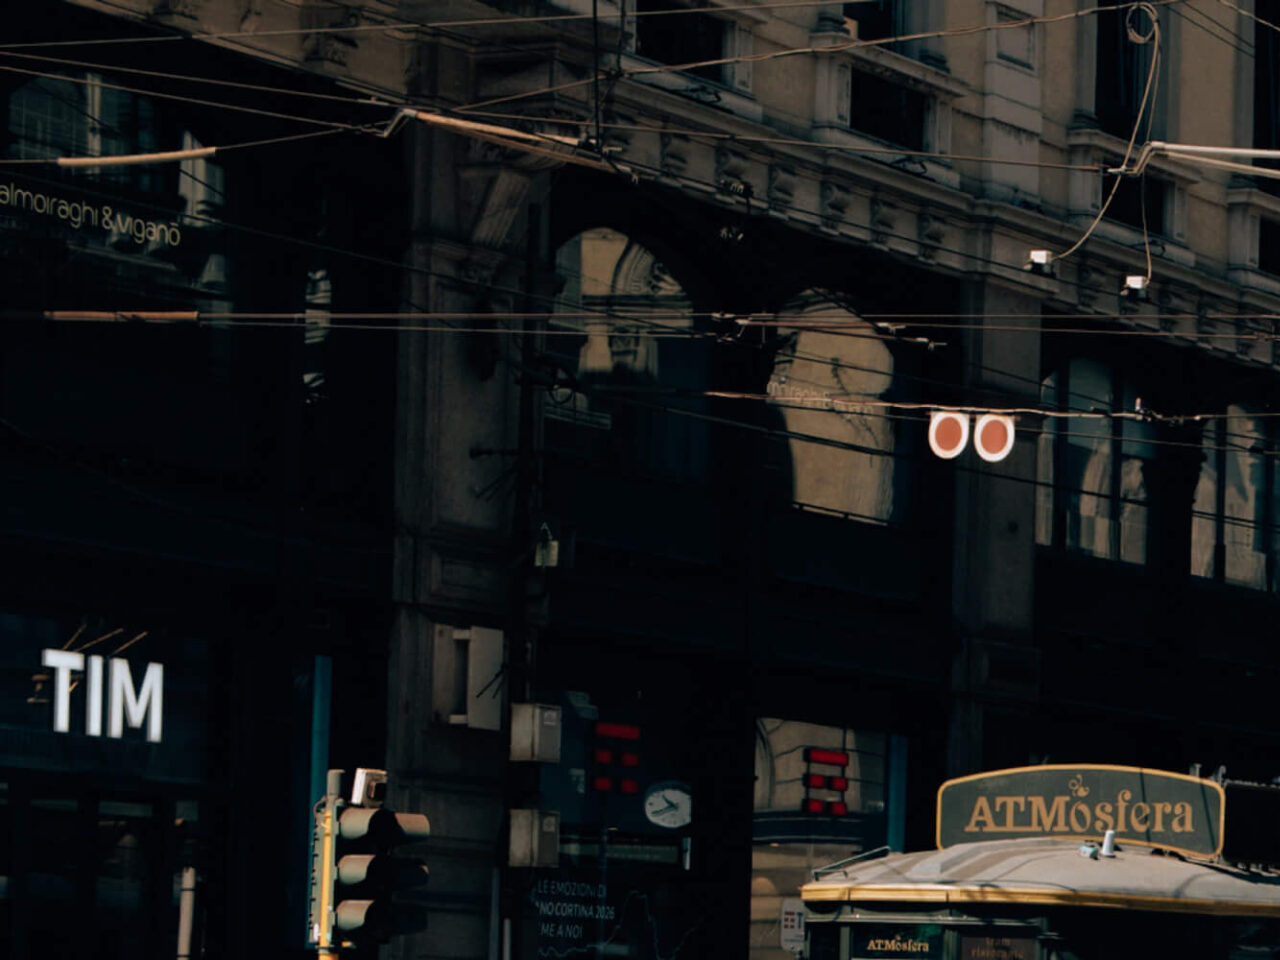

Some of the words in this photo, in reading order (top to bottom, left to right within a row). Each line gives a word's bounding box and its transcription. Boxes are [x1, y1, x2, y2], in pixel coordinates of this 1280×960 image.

[41, 648, 164, 744] TIM
[964, 788, 1194, 834] ATMosfera
[555, 903, 594, 919] CORTINA
